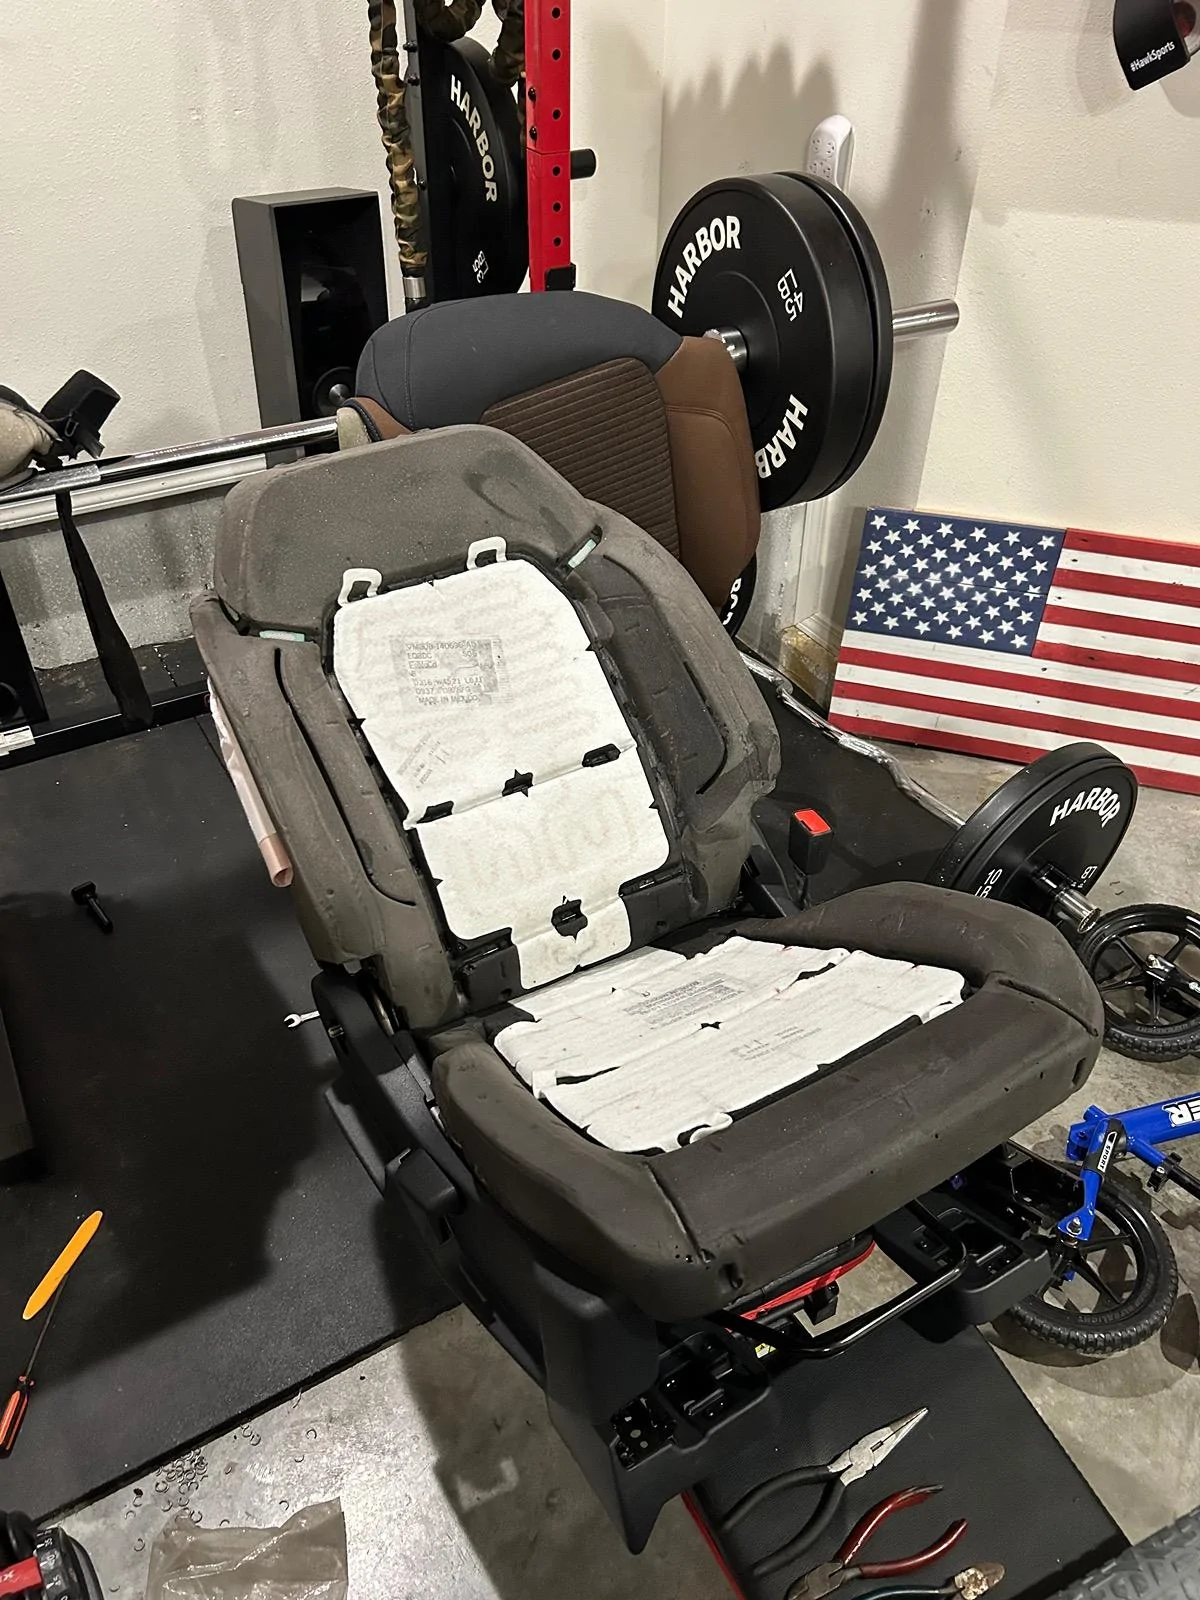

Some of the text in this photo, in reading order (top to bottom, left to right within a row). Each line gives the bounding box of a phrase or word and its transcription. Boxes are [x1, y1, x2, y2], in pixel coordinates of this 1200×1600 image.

[1130, 41, 1175, 72] #HawkSports
[450, 74, 498, 202] HARBOR
[667, 215, 741, 319] HARBOR
[777, 268, 798, 300] LB
[785, 292, 803, 321] 45
[755, 394, 808, 478] HARB
[1049, 787, 1120, 828] HARBOR
[984, 868, 1003, 885] 10
[1099, 1144, 1112, 1170] SPORT
